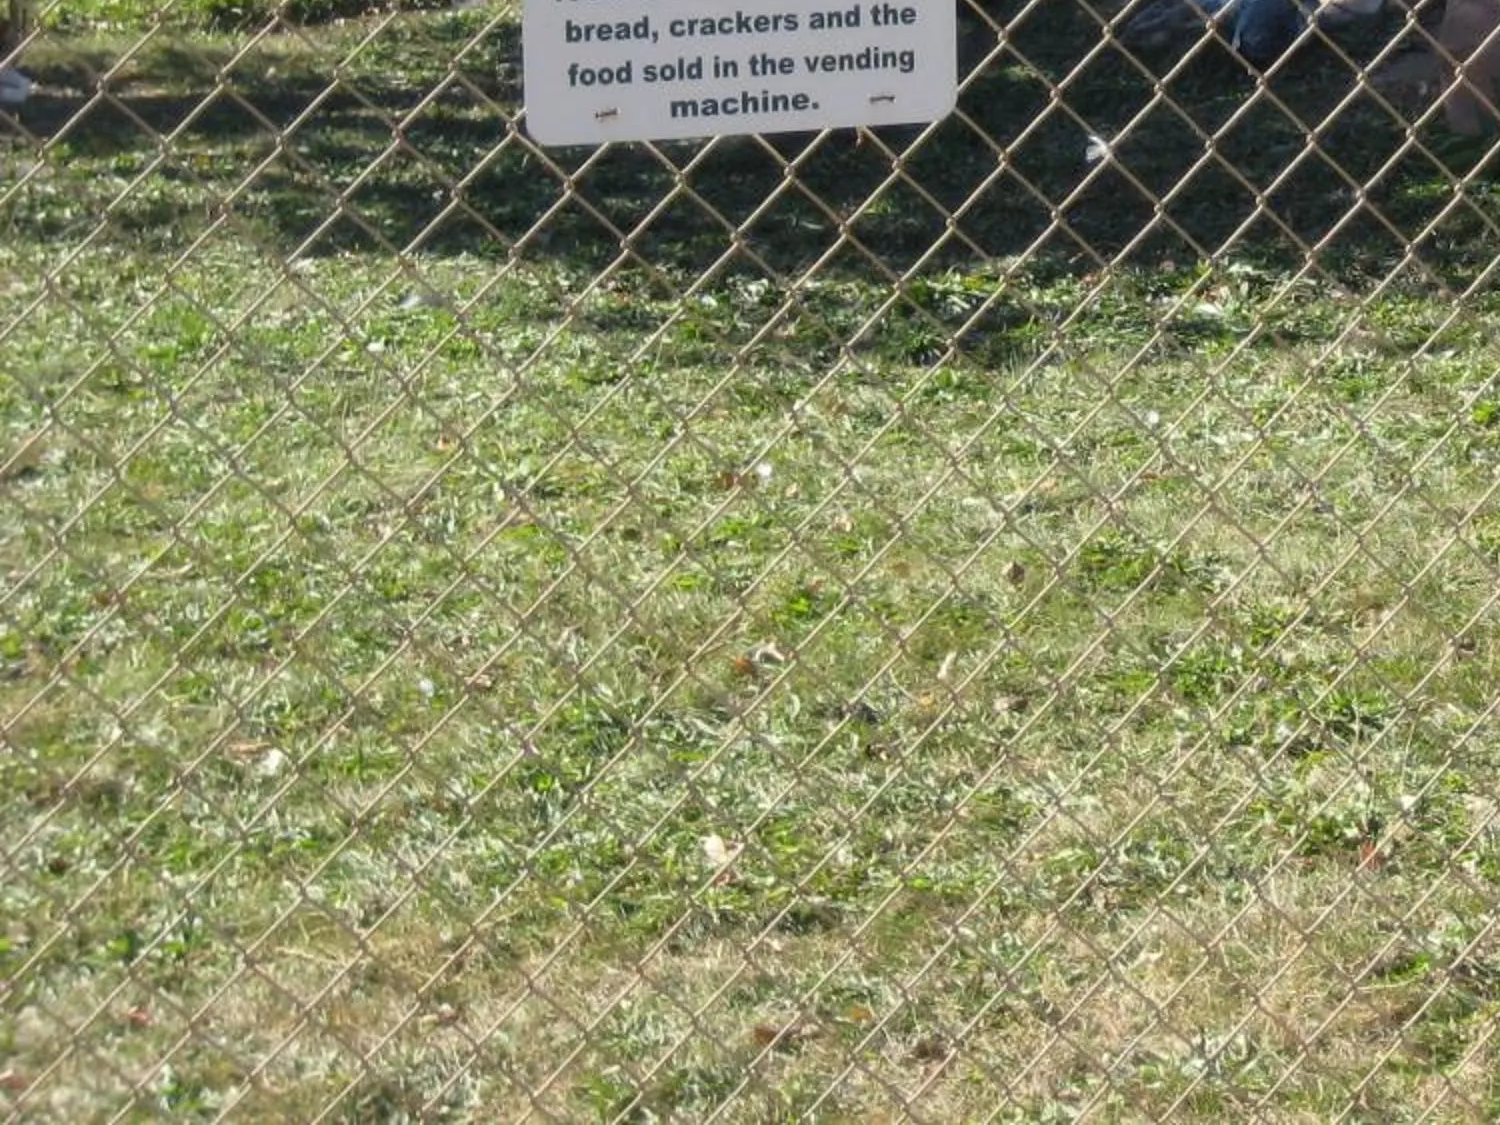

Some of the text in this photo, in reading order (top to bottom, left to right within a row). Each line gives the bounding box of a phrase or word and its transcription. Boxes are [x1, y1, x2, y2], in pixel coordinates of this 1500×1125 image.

[566, 3, 916, 43] bread, crackers and the
[568, 47, 914, 88] food sold in the vending
[670, 90, 820, 119] machine.
